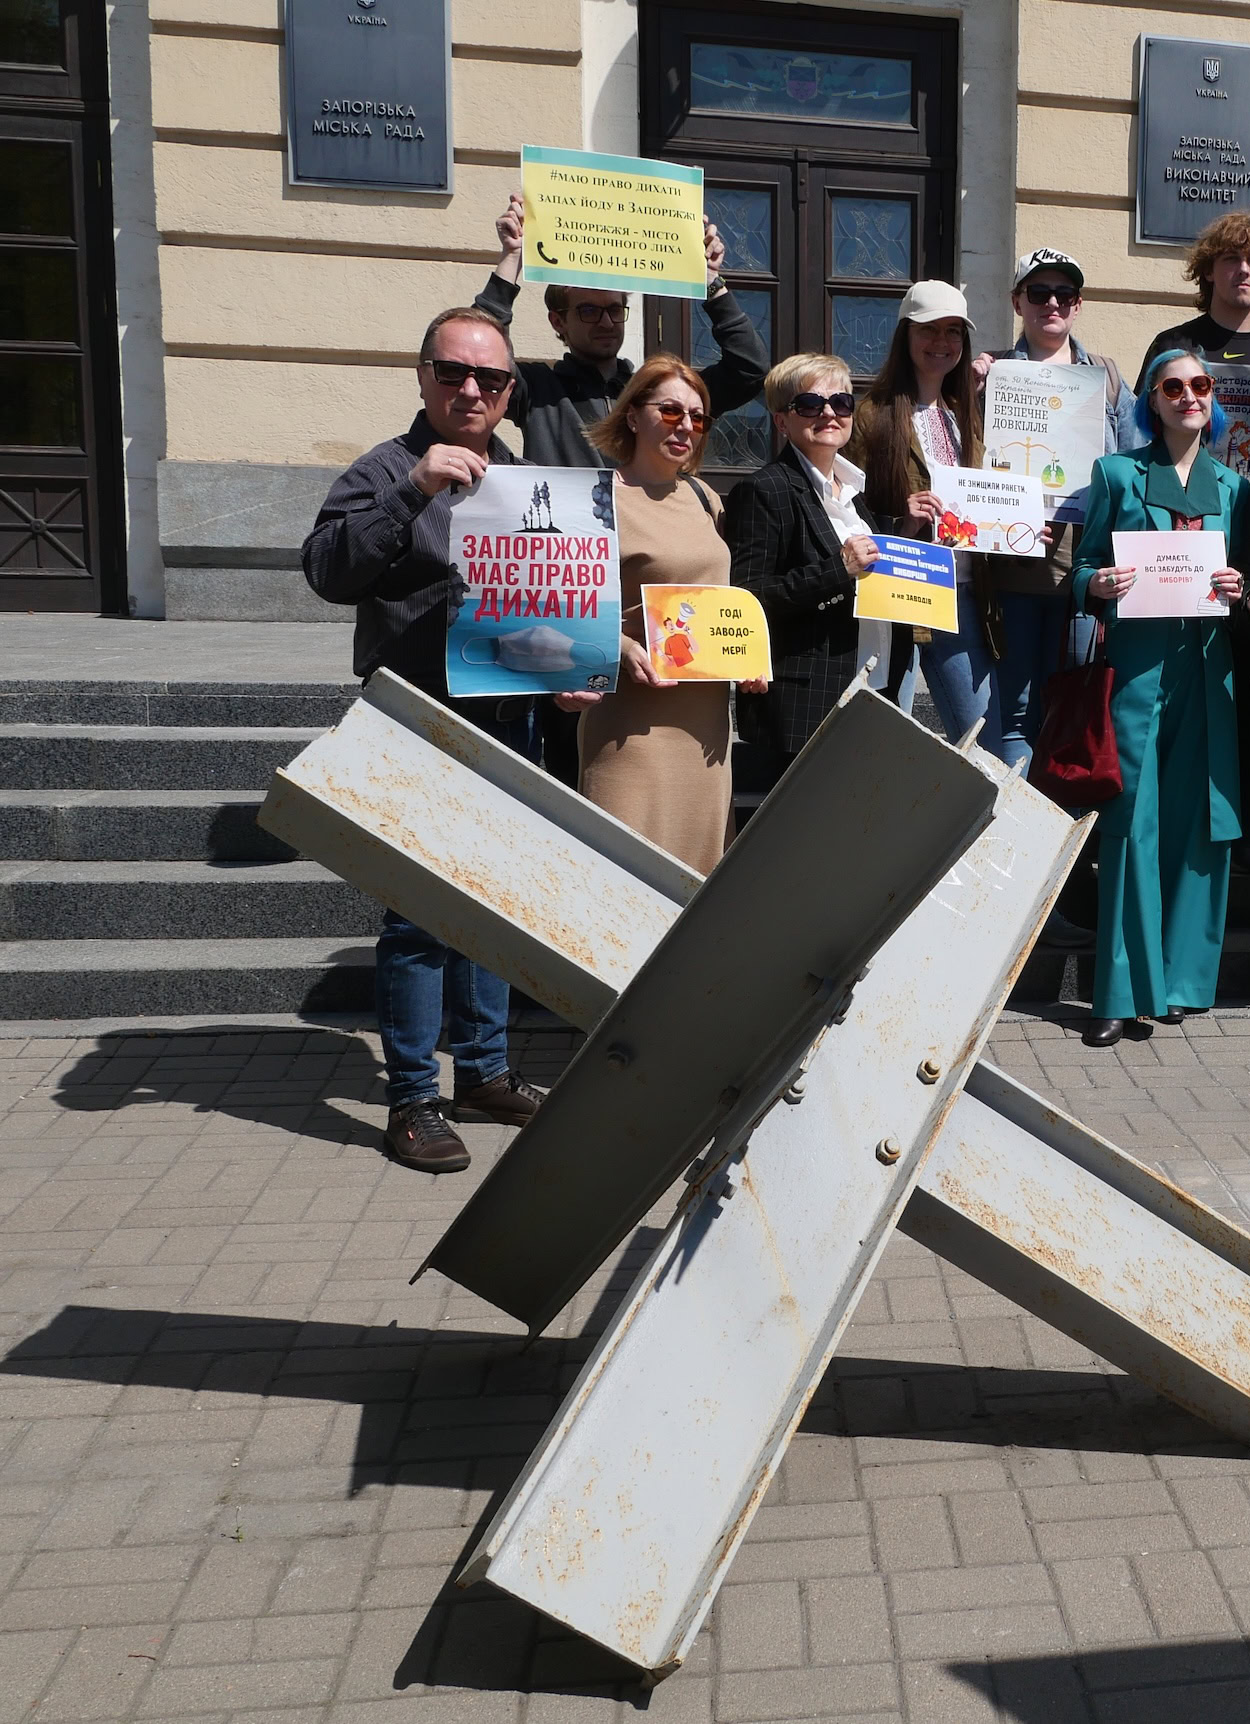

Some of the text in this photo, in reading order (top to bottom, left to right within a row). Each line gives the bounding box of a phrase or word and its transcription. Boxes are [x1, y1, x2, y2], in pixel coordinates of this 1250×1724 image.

[348, 14, 387, 26] УКРАЇНА
[1196, 88, 1228, 99] УКРАЇНА
[322, 99, 416, 118] ЗАПОРІЗЬКА
[313, 120, 425, 139] МІСЬКА РАДА
[1180, 136, 1240, 150] ЗАПОРІЗЬКА
[1172, 150, 1246, 165] МІСЬКА РАДА
[1179, 186, 1237, 202] КОМІТЕТ
[568, 251, 664, 272] 0 (50) 414 15 80
[994, 391, 1047, 407] ГАРАНТУЄ
[993, 404, 1048, 420] БЕЗПЕЧНЕ
[992, 418, 1048, 433] ДОВКІЛЛЯ
[958, 479, 966, 487] НЕ
[968, 480, 1000, 491] ЗНИЩИЛИ
[988, 496, 1020, 506] ЕКОЛОГІЯ
[462, 534, 610, 561] ЗАПОРІЖЖЯ
[467, 561, 606, 587] МАЄ ПРАВО
[1144, 565, 1156, 573] ВСІ
[1158, 565, 1193, 573] ЗАБУДУТЬ
[474, 587, 598, 623] ДИХАТИ
[906, 594, 932, 605] ЗАВОДІВ
[720, 608, 742, 619] ГОДІ
[709, 626, 754, 638] ЗАВОДО-
[722, 644, 747, 656] МЕРІЇ
